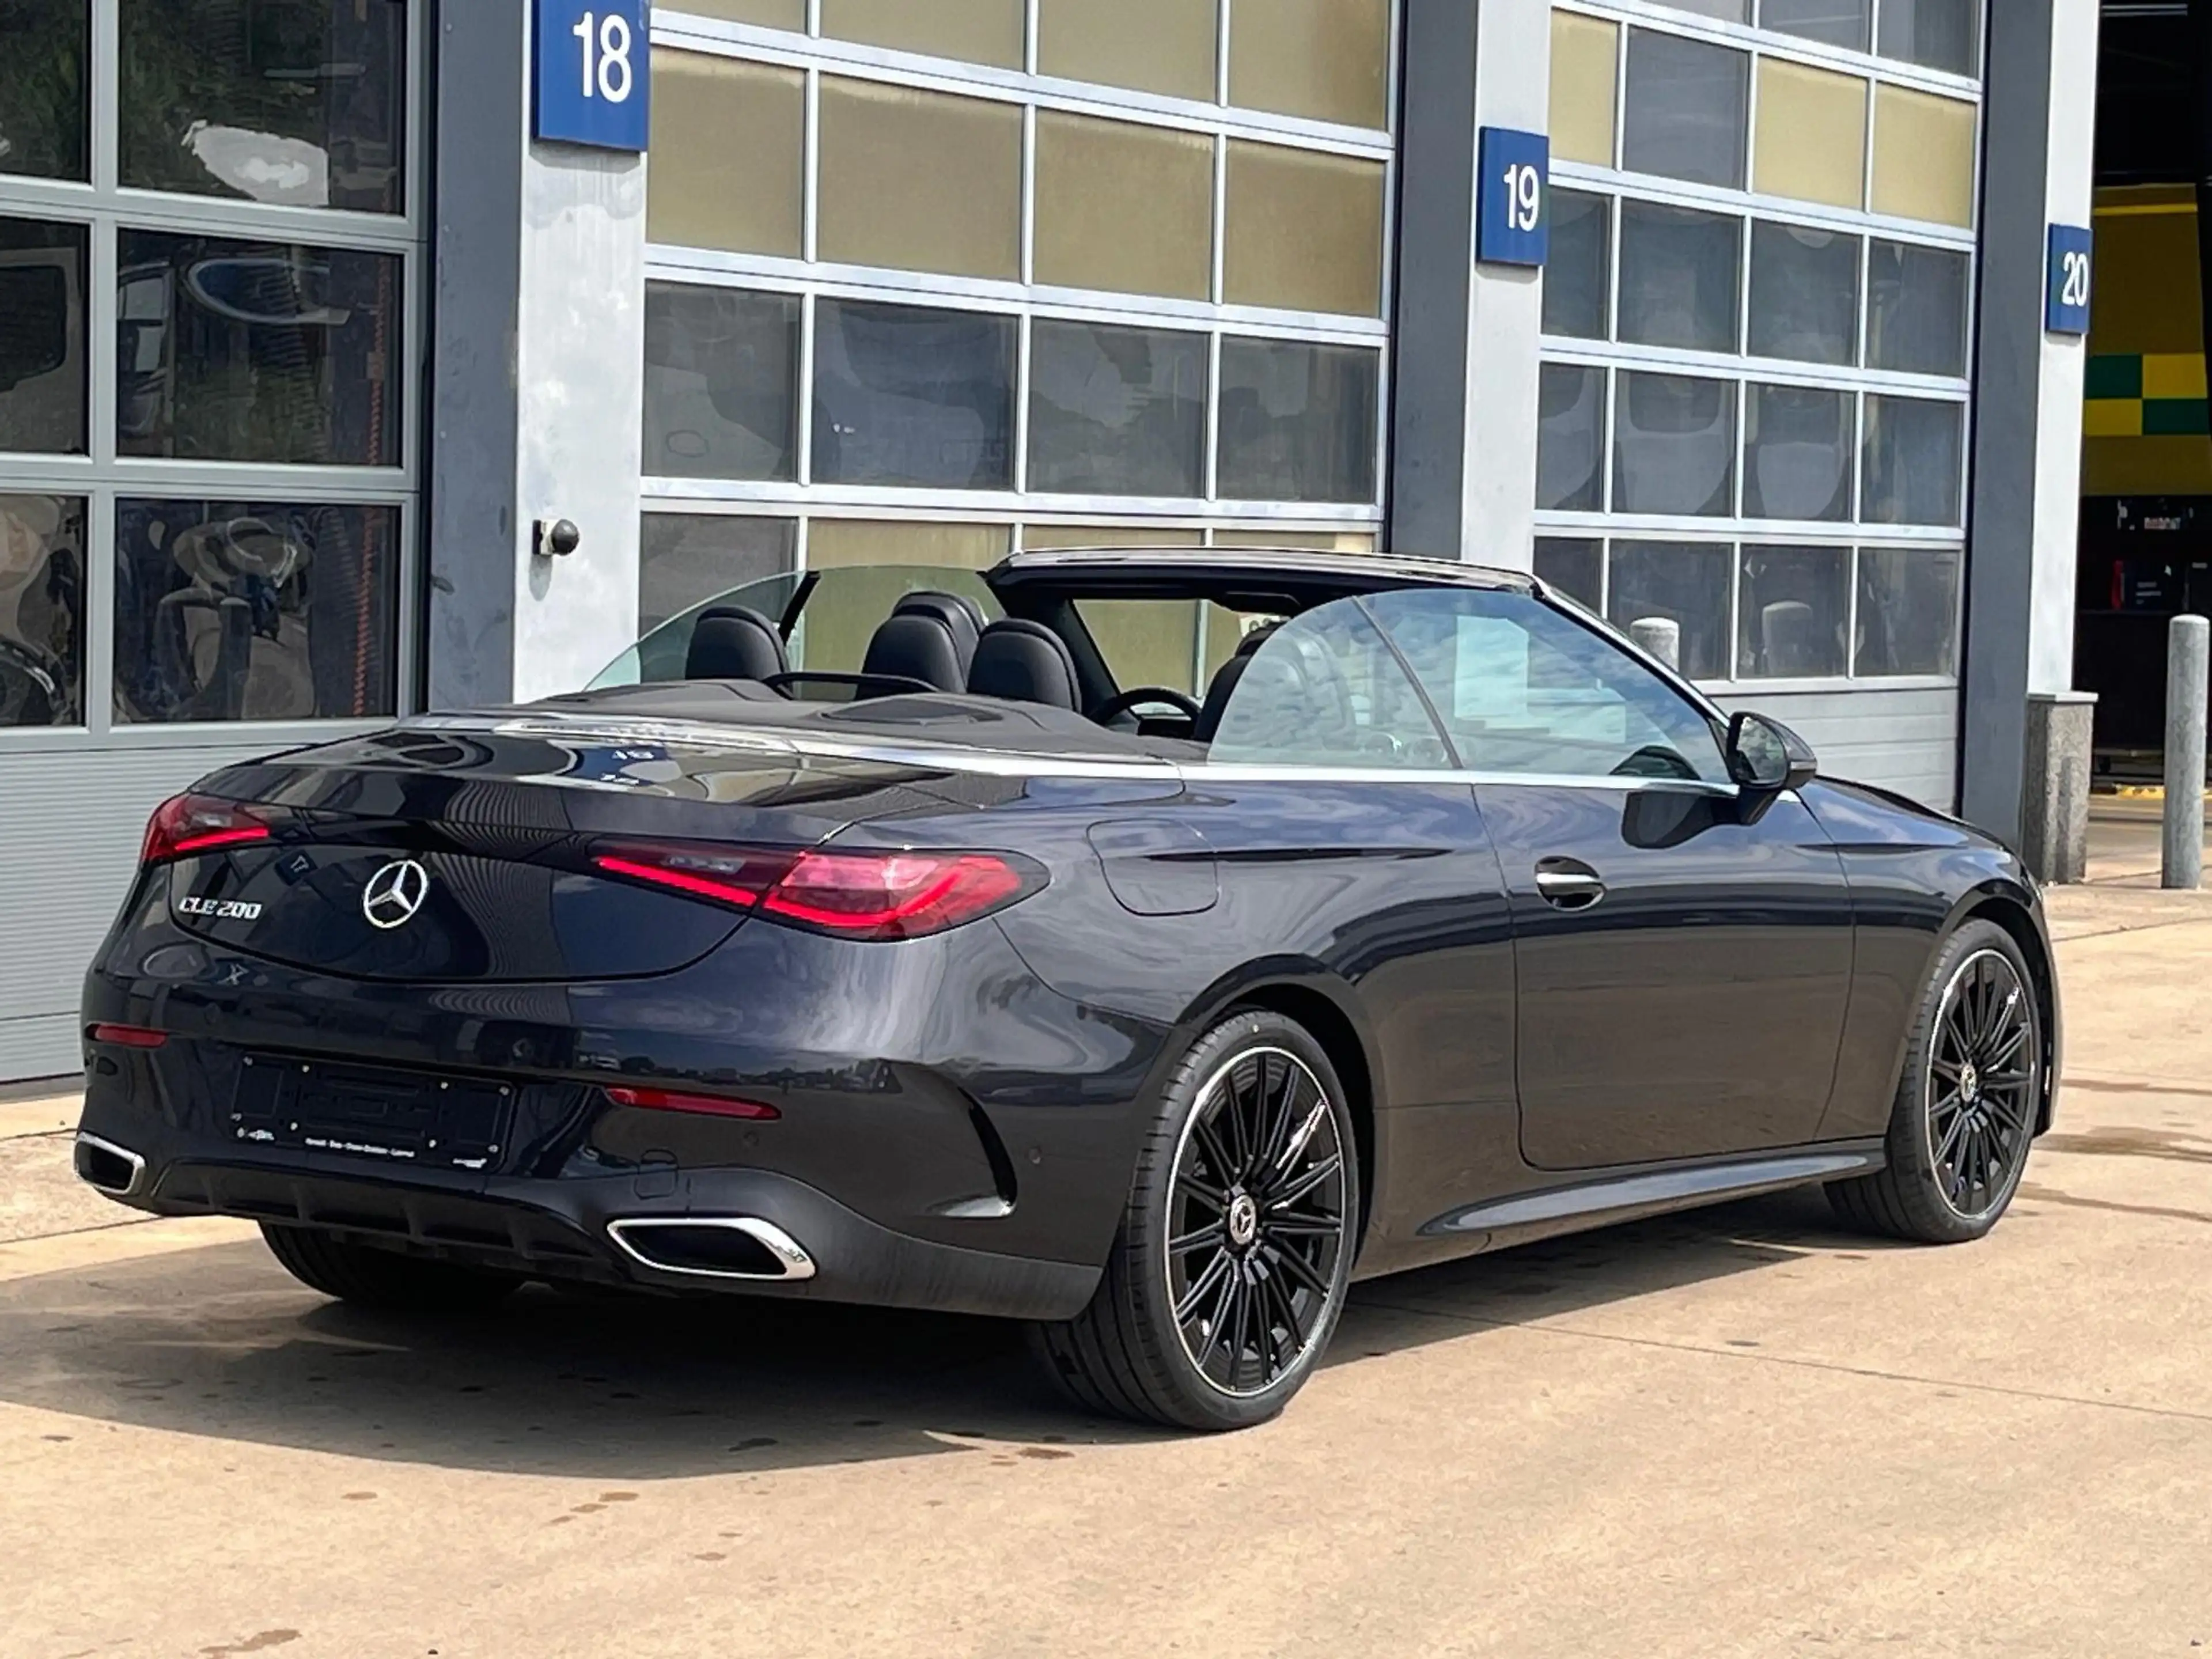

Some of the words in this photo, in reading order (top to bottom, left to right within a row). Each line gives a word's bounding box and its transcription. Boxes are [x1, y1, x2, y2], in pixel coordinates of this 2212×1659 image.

[573, 11, 632, 104] 18
[1503, 163, 1539, 232] 19
[2062, 251, 2089, 307] 20
[179, 896, 218, 915] CLE
[216, 900, 263, 920] 200
